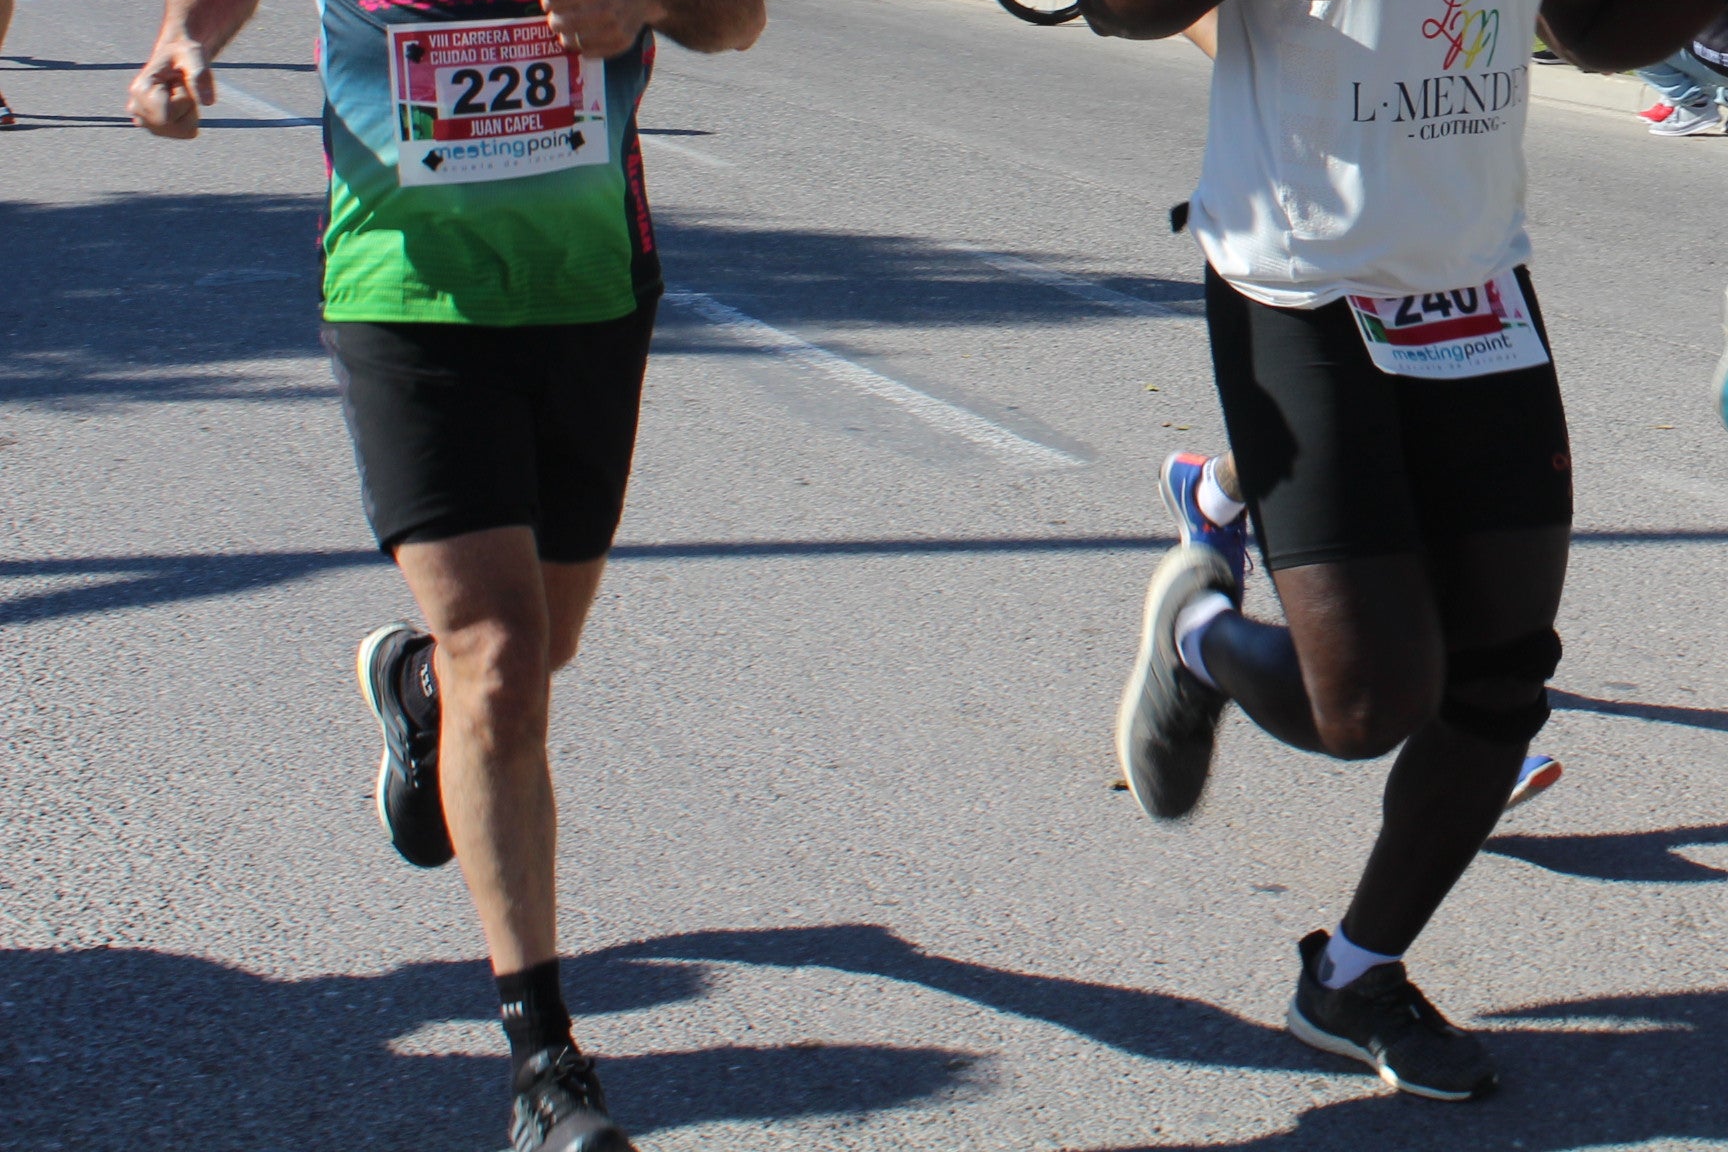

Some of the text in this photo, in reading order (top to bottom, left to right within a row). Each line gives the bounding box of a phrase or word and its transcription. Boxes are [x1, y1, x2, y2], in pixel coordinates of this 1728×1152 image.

[429, 26, 556, 48] VIII CARRERA POPUL
[430, 41, 562, 65] CIUDAD DE ROQUETAS
[451, 62, 556, 115] 228
[470, 114, 544, 137] JUAN CAPEL
[1420, 116, 1500, 140] CLOTHING
[1386, 287, 1479, 327] 240
[1392, 334, 1513, 363] meetingpoint
